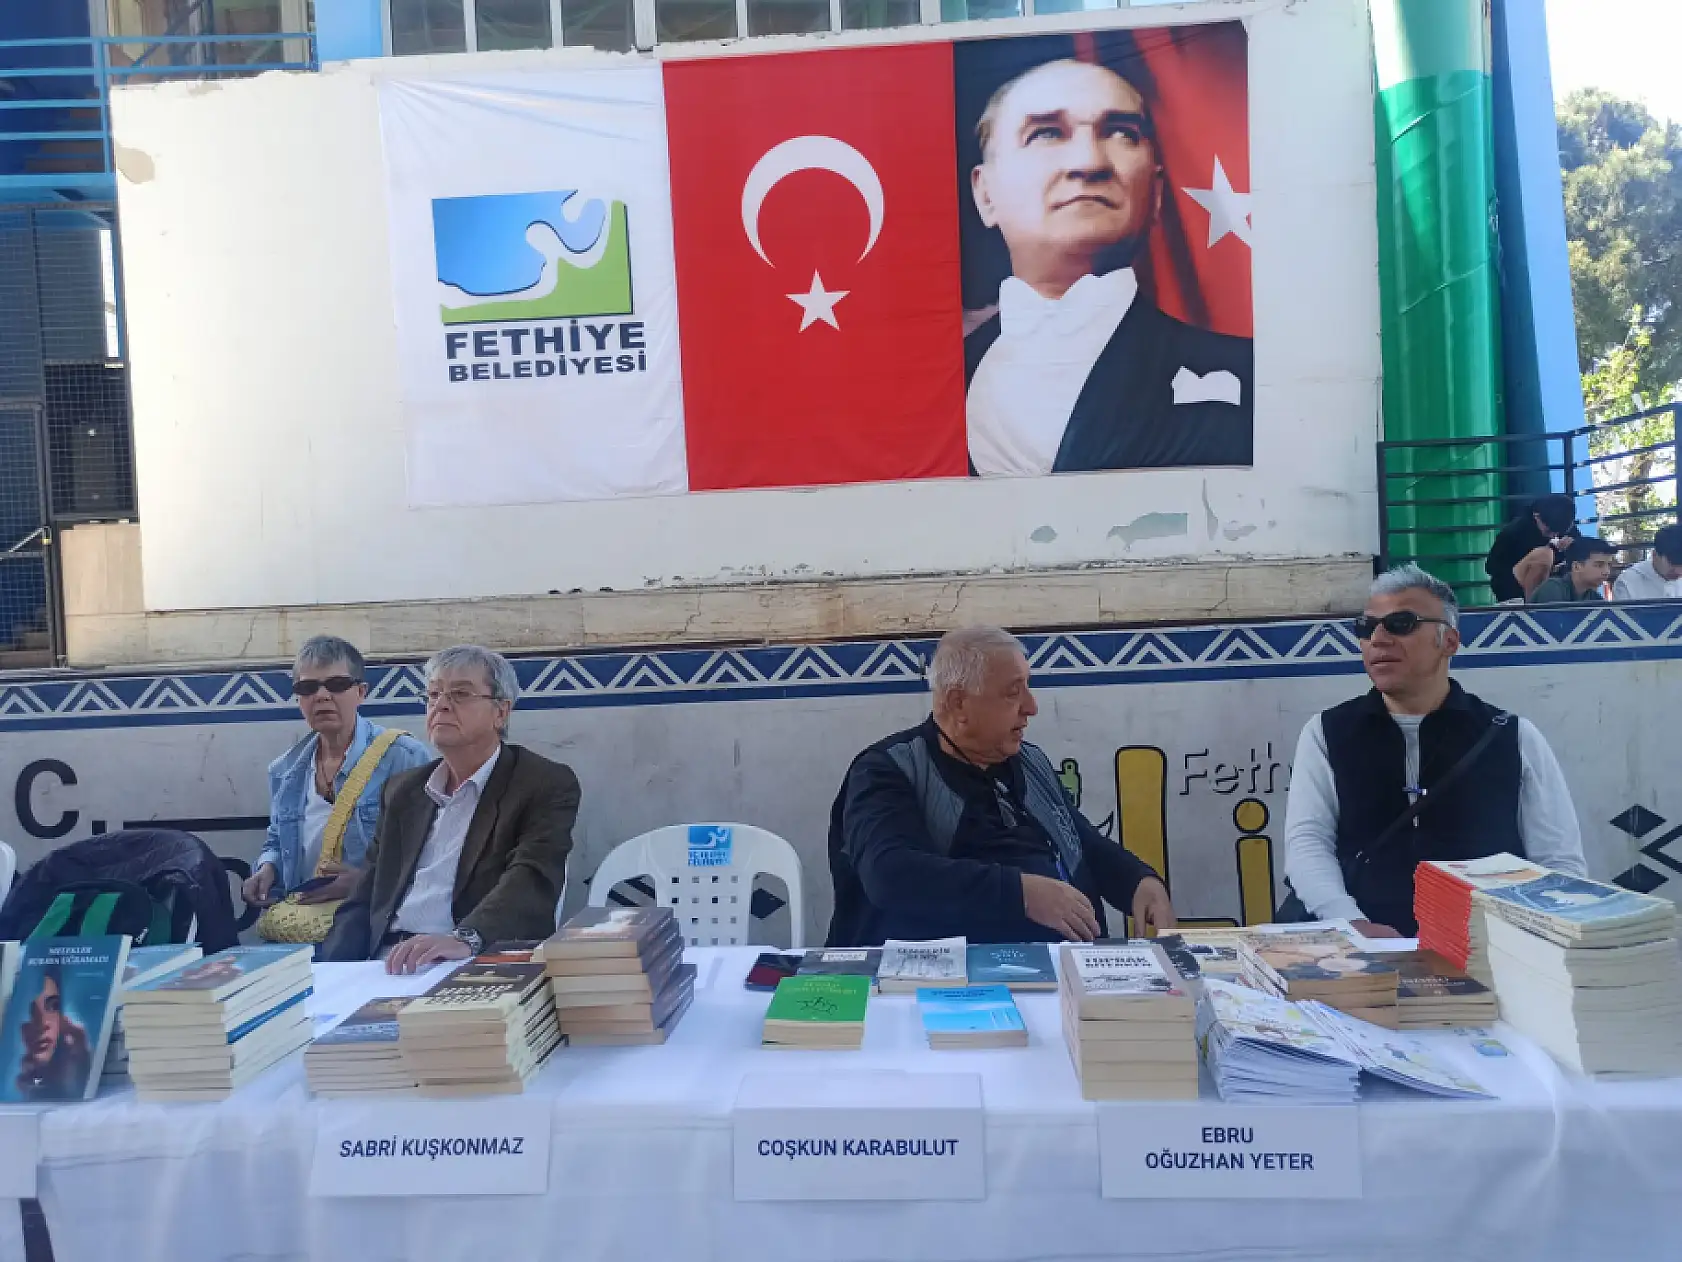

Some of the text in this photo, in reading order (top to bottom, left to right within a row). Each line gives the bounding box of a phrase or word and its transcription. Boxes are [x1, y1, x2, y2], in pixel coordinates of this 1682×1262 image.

[445, 319, 647, 360] FETHİYE
[448, 350, 647, 382] BELEDİYESİ
[1201, 1127, 1254, 1143] EBRU
[339, 1136, 525, 1161] SABRİ KUŞKONMAZ
[757, 1139, 960, 1160] COŞKUN KARABULUT
[1145, 1148, 1315, 1170] OĞUZHAN YETER
